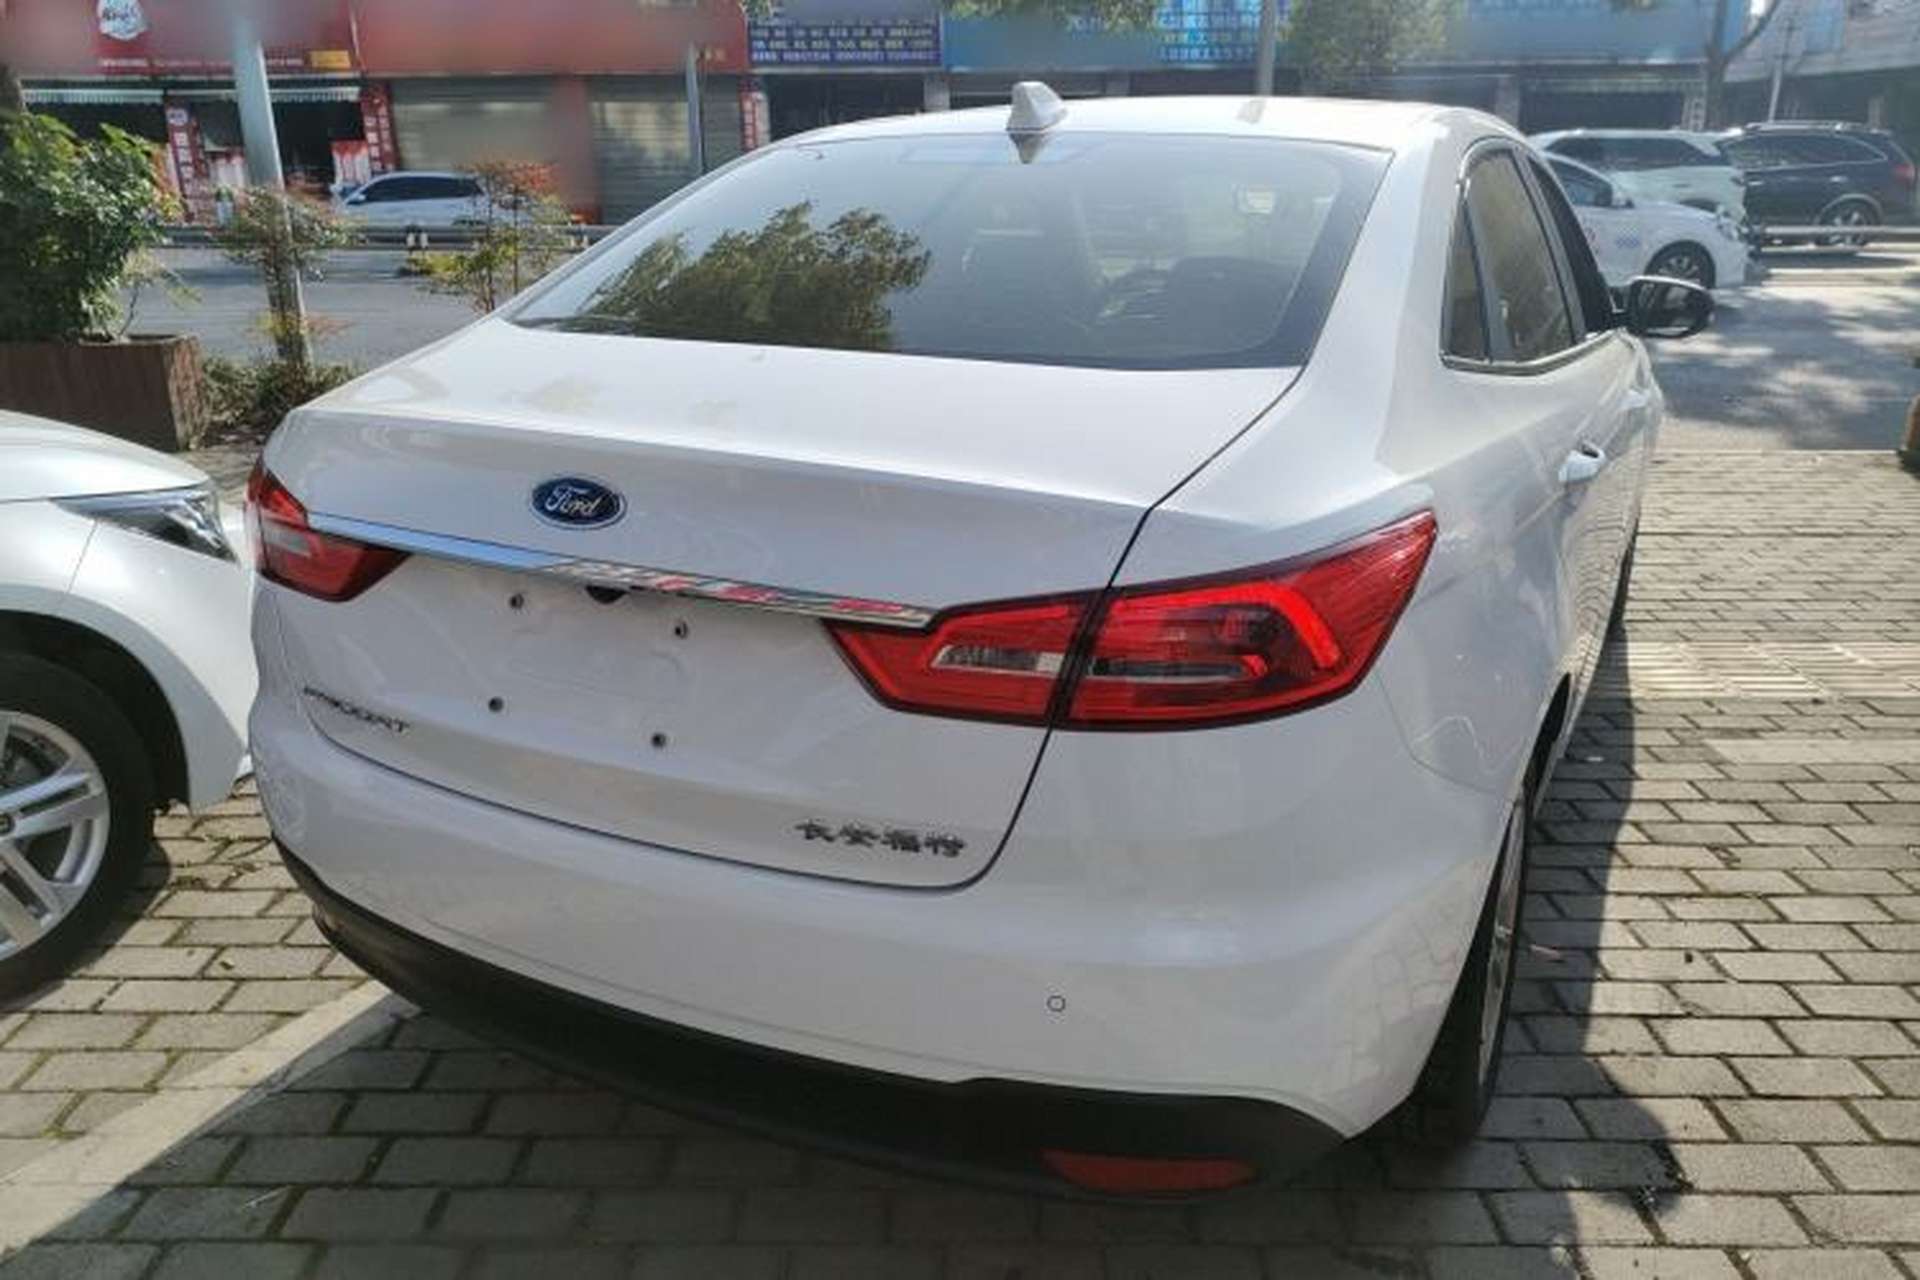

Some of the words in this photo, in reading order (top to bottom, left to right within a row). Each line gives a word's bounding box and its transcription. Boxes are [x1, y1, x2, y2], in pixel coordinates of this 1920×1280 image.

[545, 485, 612, 516] Ford
[794, 819, 966, 858] 长安福特
